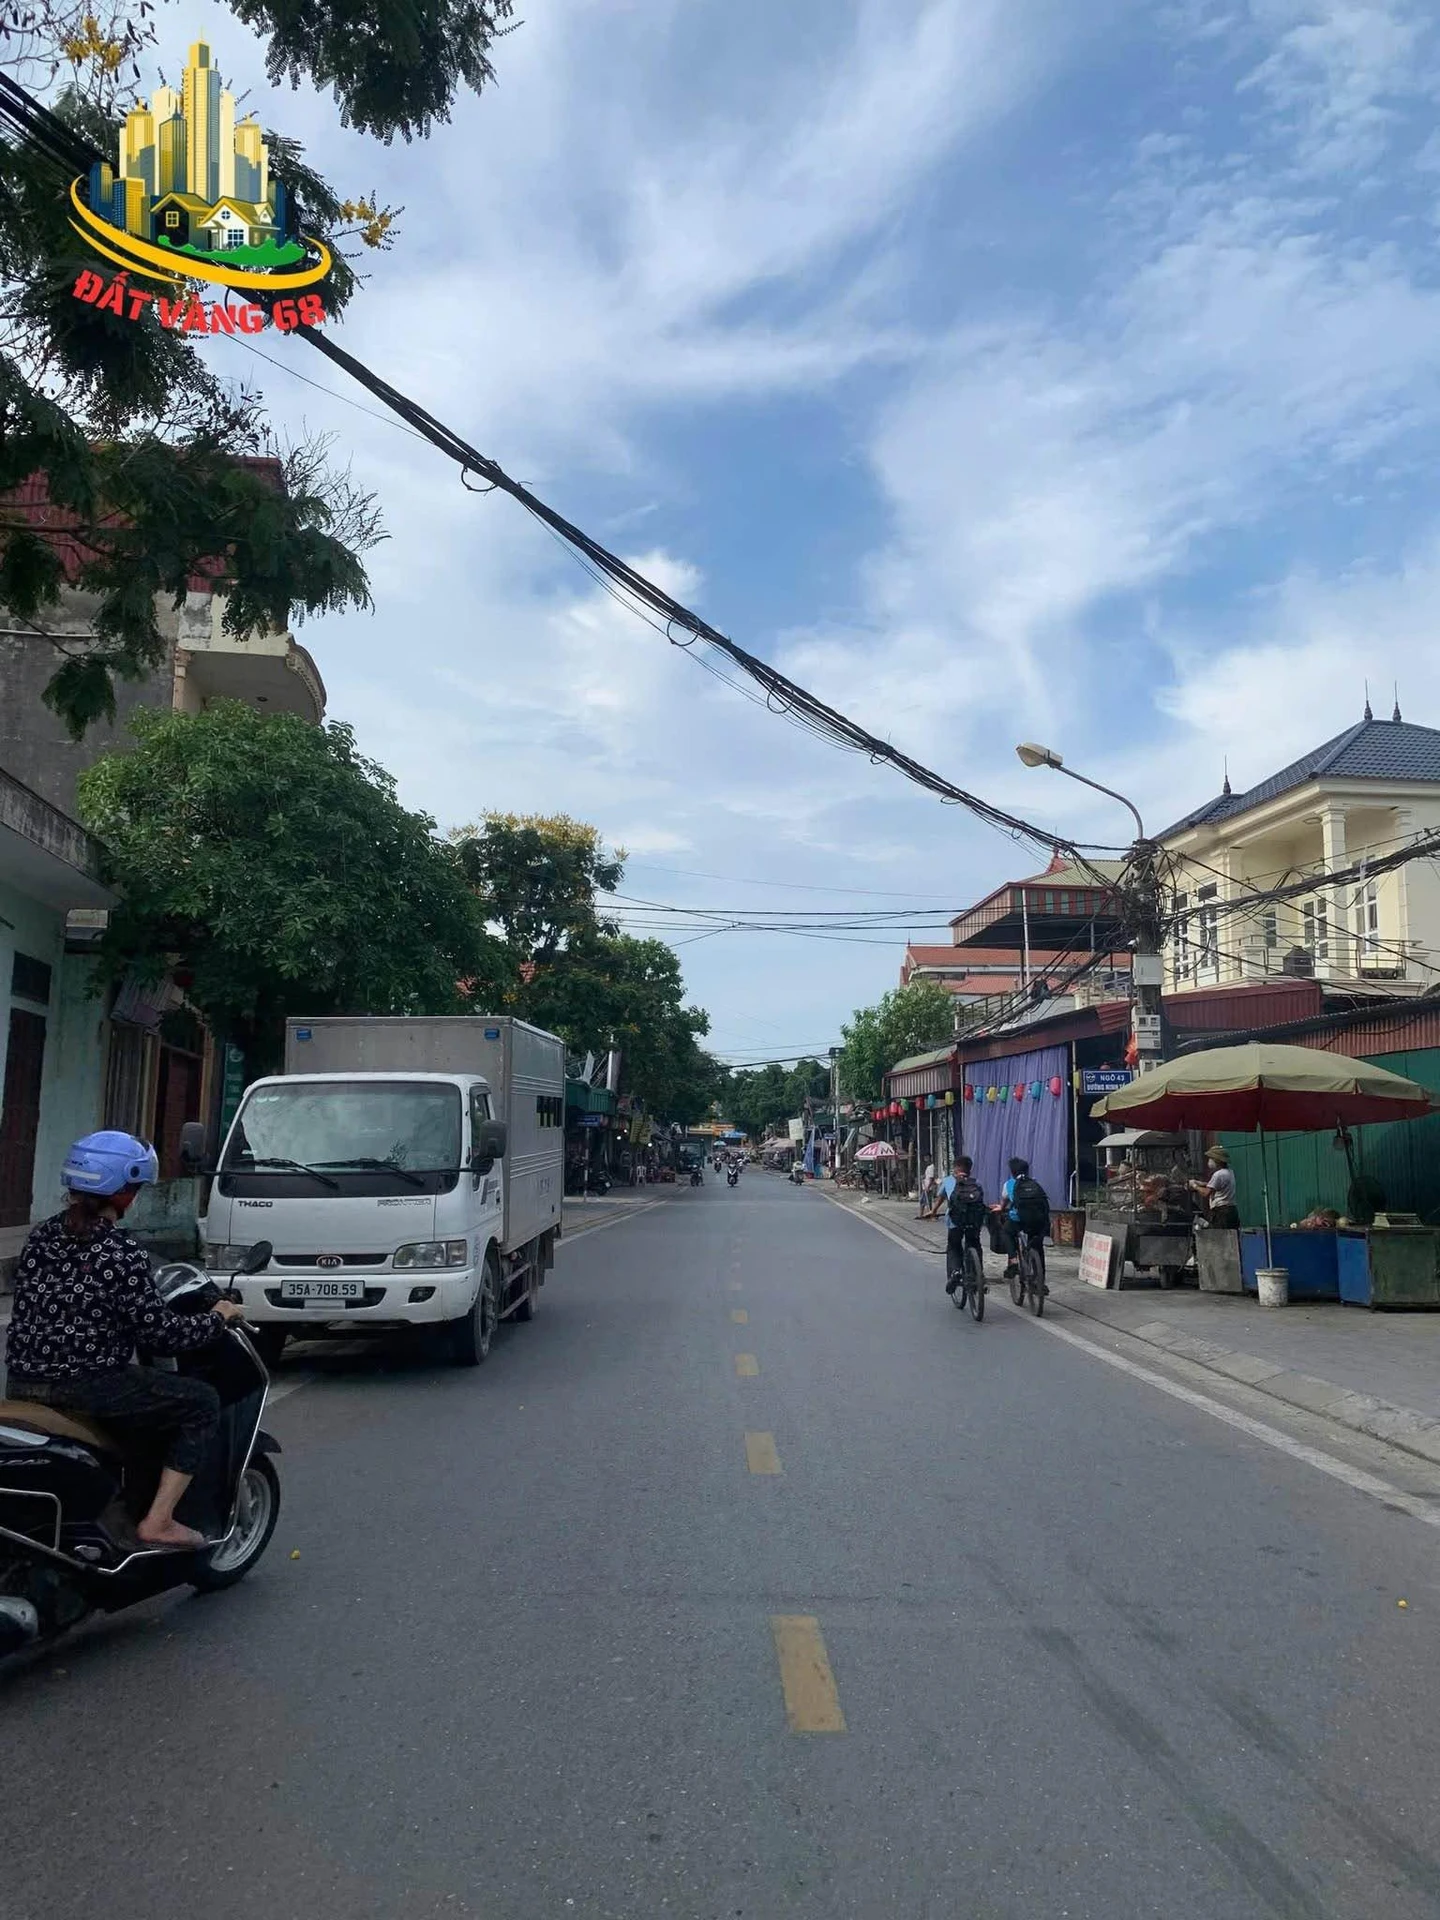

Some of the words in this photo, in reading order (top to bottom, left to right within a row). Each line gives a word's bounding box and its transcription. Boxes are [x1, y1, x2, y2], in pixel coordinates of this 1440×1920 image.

[238, 1200, 273, 1208] THACO
[320, 1257, 338, 1266] KIA
[288, 1283, 357, 1296] 35A-708.59
